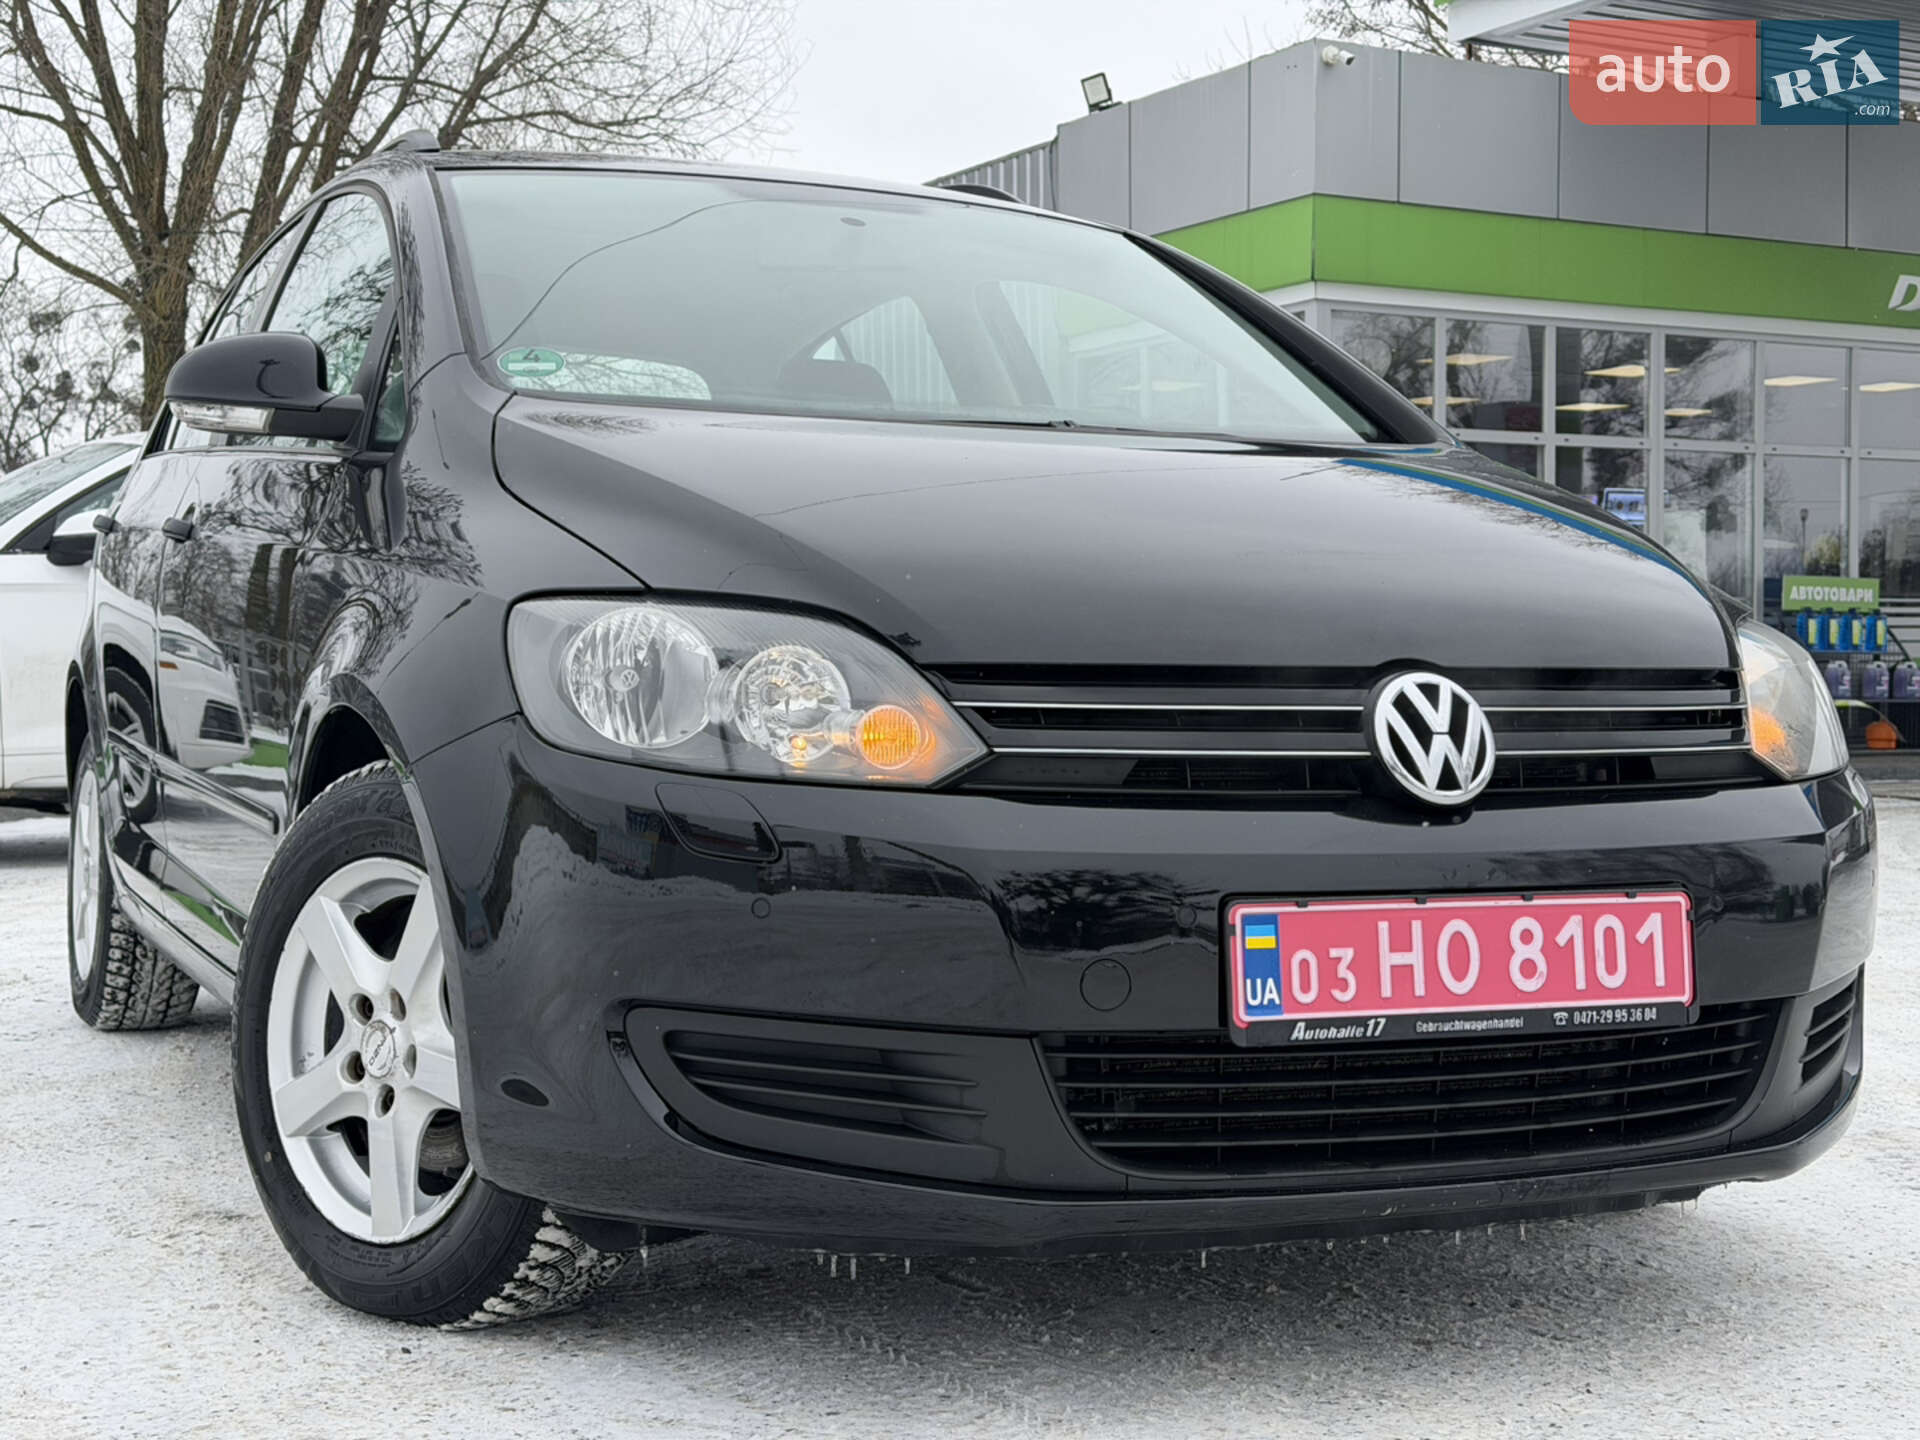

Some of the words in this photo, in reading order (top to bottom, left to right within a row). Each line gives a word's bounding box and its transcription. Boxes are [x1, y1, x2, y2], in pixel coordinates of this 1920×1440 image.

[1790, 585, 1873, 603] АВТОТОВАРИ
[1380, 676, 1486, 797] VW
[1291, 948, 1357, 1004] 03
[1377, 918, 1480, 998] HO
[1509, 912, 1666, 992] 8101
[1245, 978, 1281, 1006] UA
